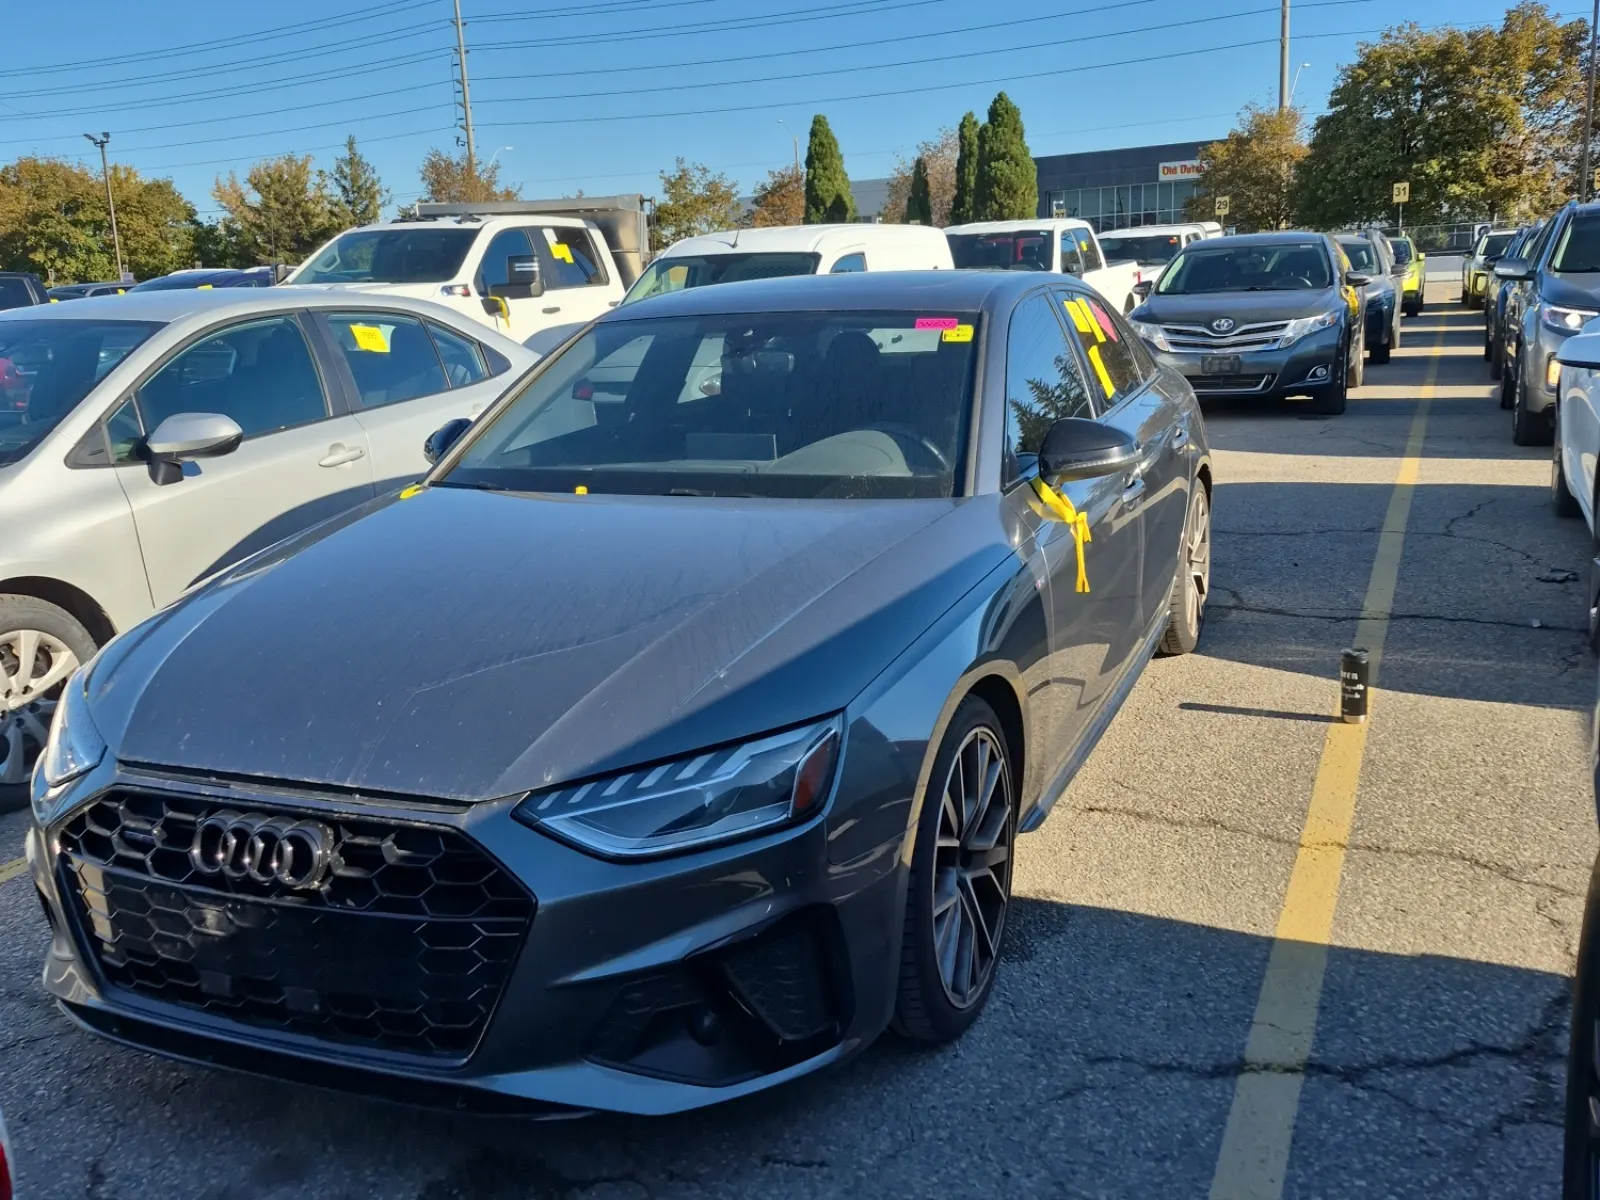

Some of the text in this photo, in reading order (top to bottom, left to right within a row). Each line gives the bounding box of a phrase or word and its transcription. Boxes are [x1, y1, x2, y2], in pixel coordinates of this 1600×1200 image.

[1162, 166, 1177, 175] Old
[1395, 186, 1406, 196] 31
[1217, 200, 1228, 209] 29
